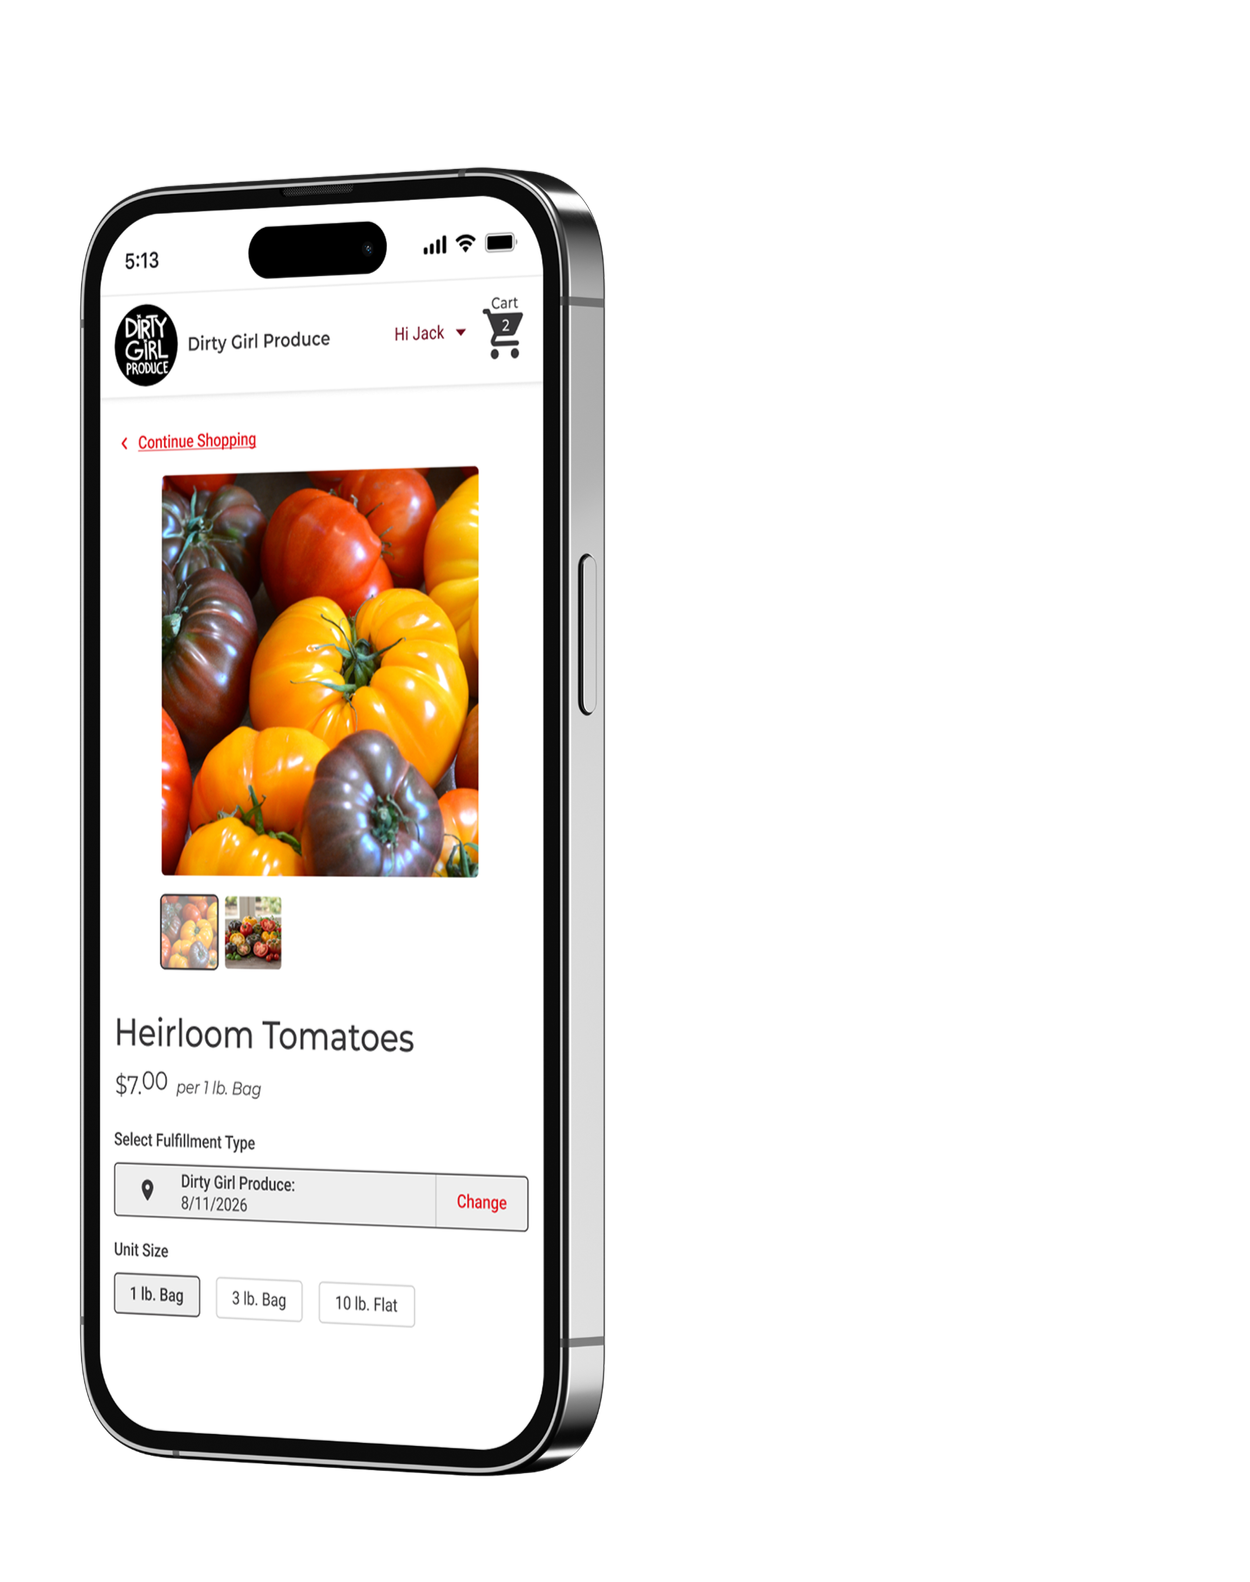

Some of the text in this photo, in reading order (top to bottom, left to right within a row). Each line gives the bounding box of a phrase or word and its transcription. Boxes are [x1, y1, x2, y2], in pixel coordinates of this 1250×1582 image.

[125, 250, 160, 270] 5:13
[491, 296, 519, 310] Cart
[394, 324, 445, 342] Hi Jack
[502, 318, 510, 332] 2
[188, 331, 331, 355] Dirty Girl Produce
[126, 361, 169, 376] PRODUCE
[138, 431, 256, 450] Continue Shopping
[116, 1016, 415, 1053] Heirloom Tomatoes
[115, 1070, 262, 1100] $7.00 per 1 lb. Bag
[114, 1131, 256, 1154] Select Fulfillment Type
[181, 1173, 295, 1193] Dirty Girl Produce:
[181, 1195, 248, 1213] 8/11/2026
[456, 1193, 508, 1214] Change
[114, 1241, 169, 1259] Unit Size
[130, 1285, 184, 1307] 1 lb. Bag
[232, 1290, 287, 1311] 3 lb. Bag
[335, 1295, 398, 1313] 10 lb. Flat
